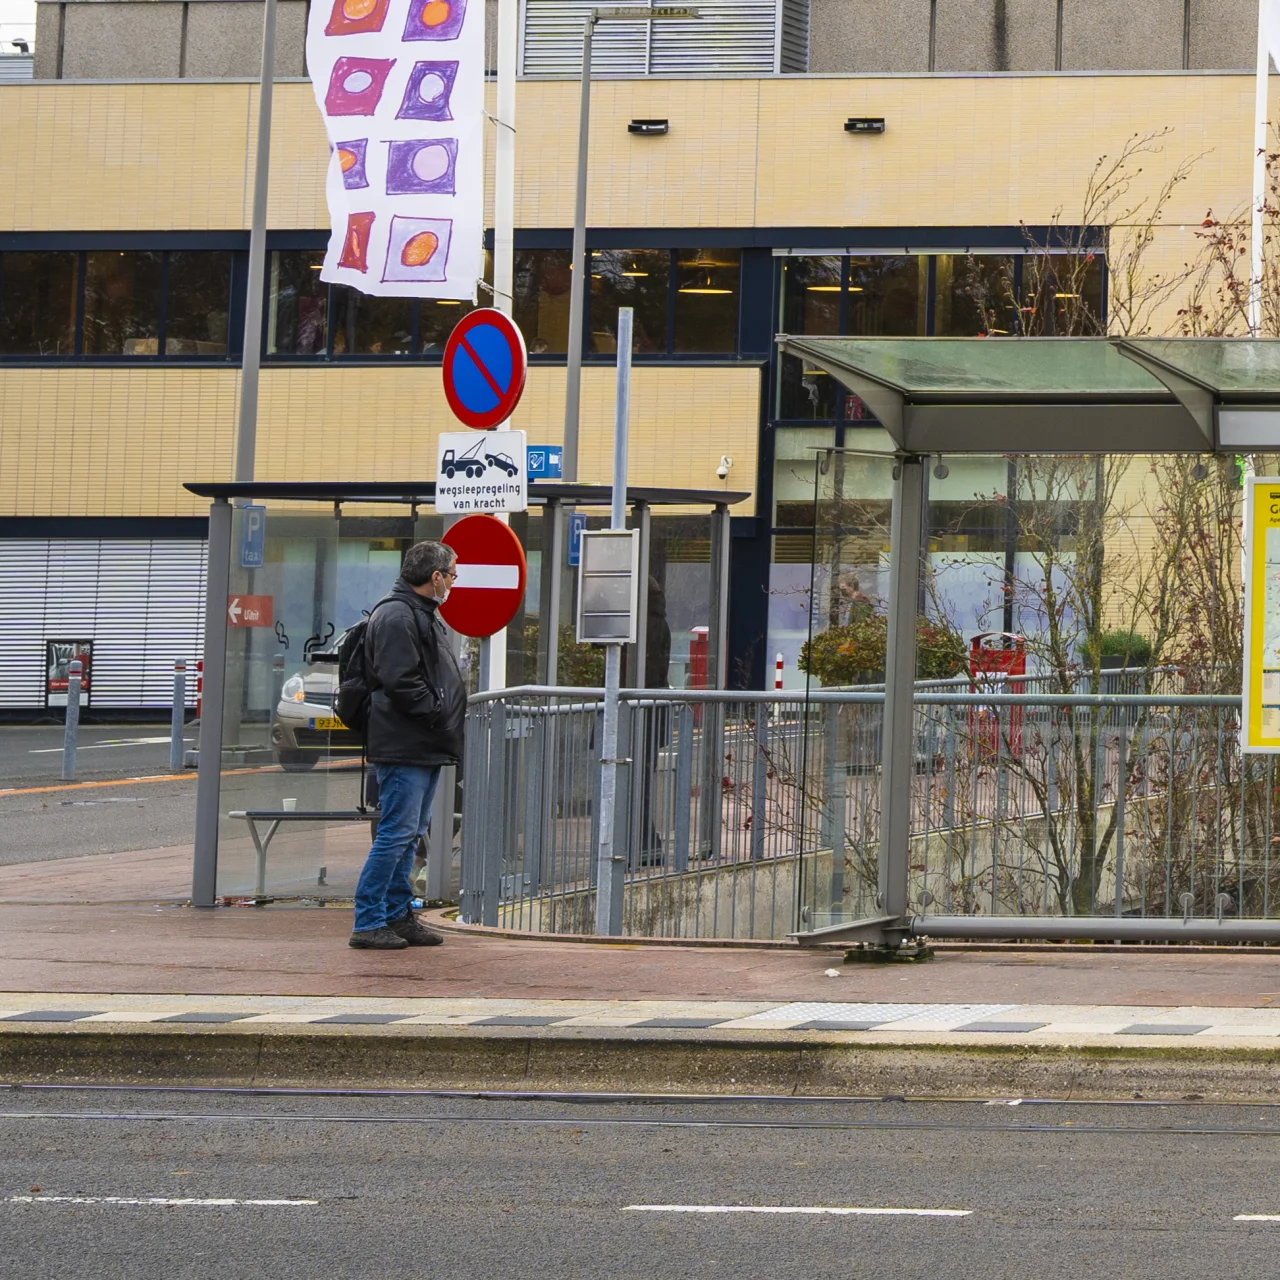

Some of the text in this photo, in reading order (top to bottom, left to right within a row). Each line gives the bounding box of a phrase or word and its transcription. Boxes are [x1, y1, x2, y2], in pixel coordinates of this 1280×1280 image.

[439, 483, 521, 498] wegsleepregeling
[453, 498, 506, 509] van kracht
[247, 512, 260, 542] P
[244, 548, 262, 562] taxi
